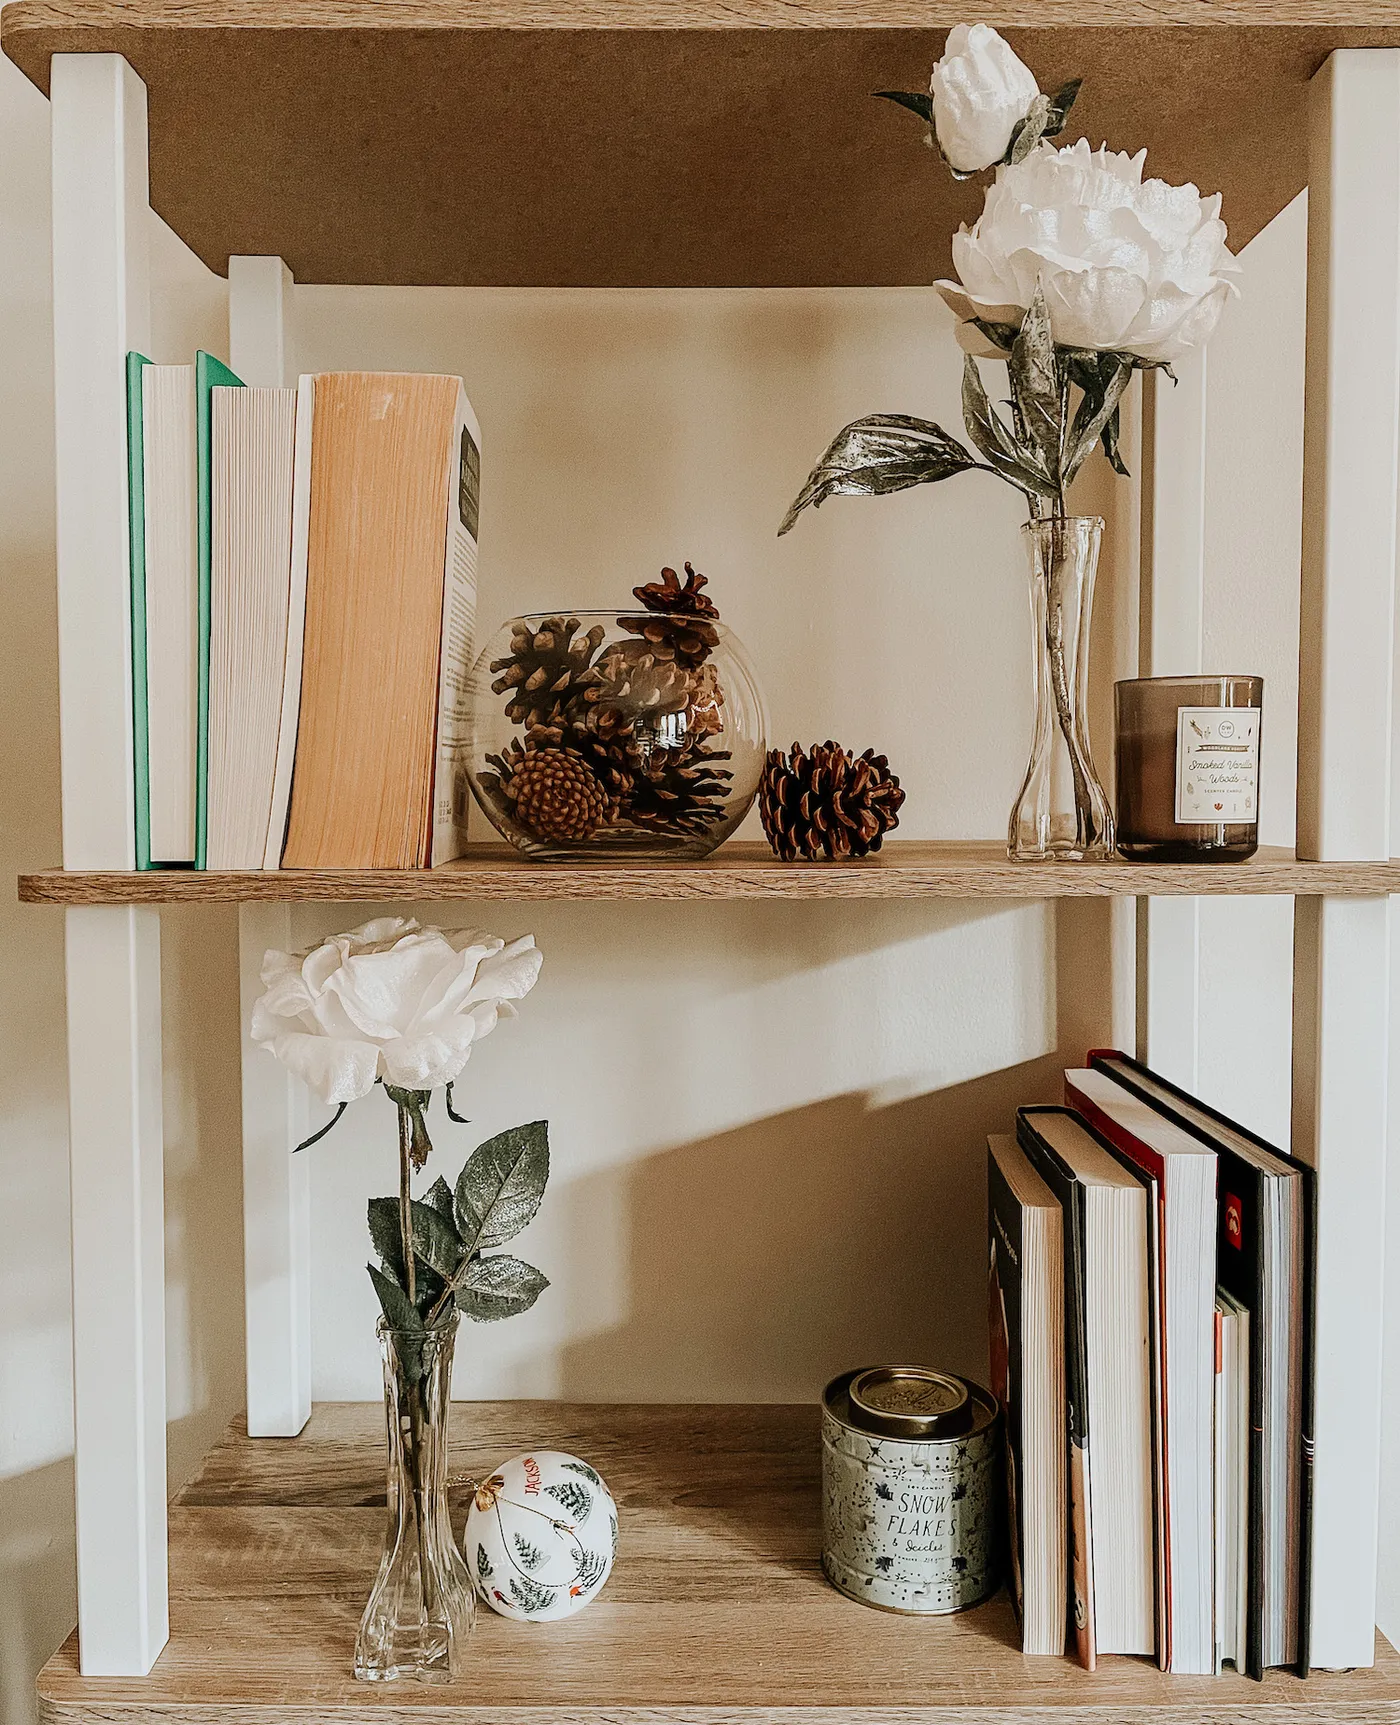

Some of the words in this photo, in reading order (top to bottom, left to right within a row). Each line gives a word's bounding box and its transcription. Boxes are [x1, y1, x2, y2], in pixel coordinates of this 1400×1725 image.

[1188, 759, 1225, 771] Smoked
[1227, 759, 1253, 770] Vanilla
[1209, 773, 1240, 784] Woods
[522, 1457, 542, 1497] JACKSON
[898, 1492, 951, 1514] SNOW
[887, 1515, 957, 1537] FLAKES
